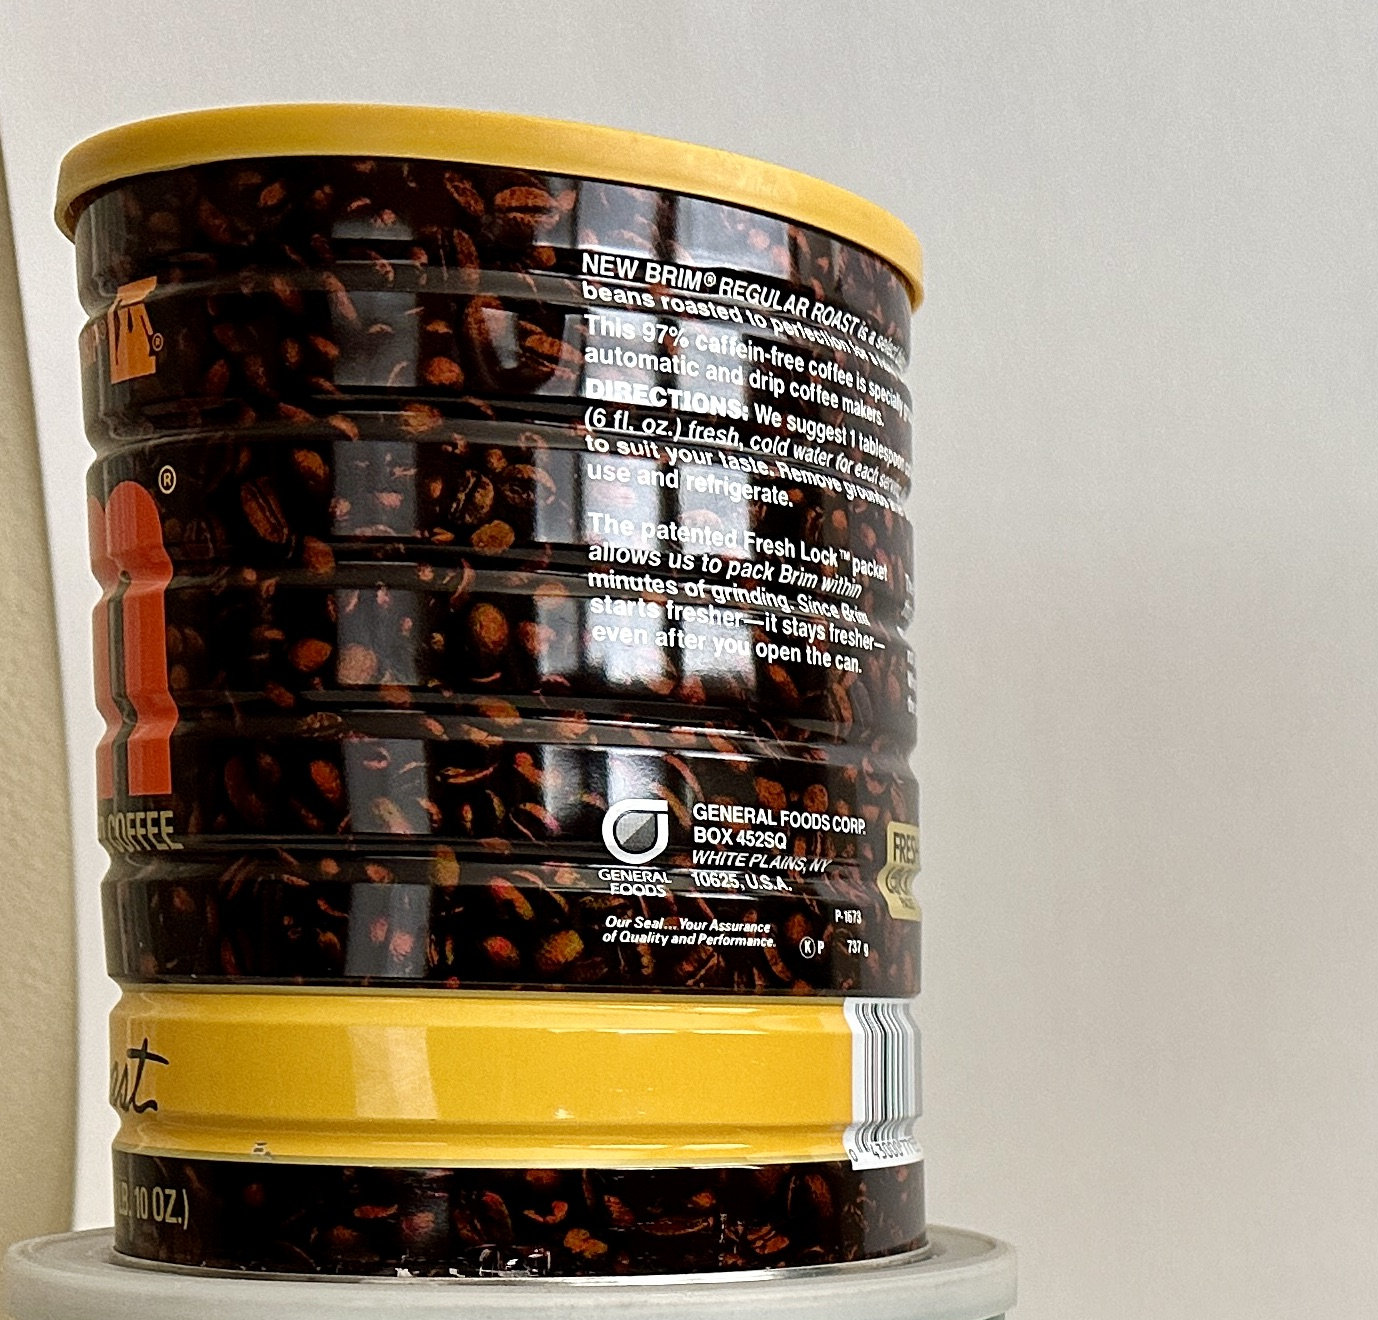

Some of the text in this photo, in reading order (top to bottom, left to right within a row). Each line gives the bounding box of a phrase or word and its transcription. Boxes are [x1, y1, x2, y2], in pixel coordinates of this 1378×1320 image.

[582, 252, 639, 279] NEW
[718, 276, 808, 317] REGULAR
[812, 305, 857, 335] ROAST
[584, 344, 884, 426] automatic and drip coffee makers.
[587, 463, 794, 508] use and refrigerate.
[588, 543, 862, 599] allows us to pack Brim within
[106, 810, 184, 851] COFFEE
[693, 803, 866, 836] GENERAL FOODS CORP.
[694, 826, 787, 850] BOX 452SQ
[692, 850, 833, 873] WHITE PLAINS, NY
[598, 869, 672, 884] GENERAL
[610, 883, 667, 897] FOODS
[692, 872, 793, 892] 10625, U.S.A.
[603, 931, 777, 948] of Quality and Performance.
[847, 940, 869, 957] 737 g
[134, 1188, 189, 1230] 10 OZ.)
